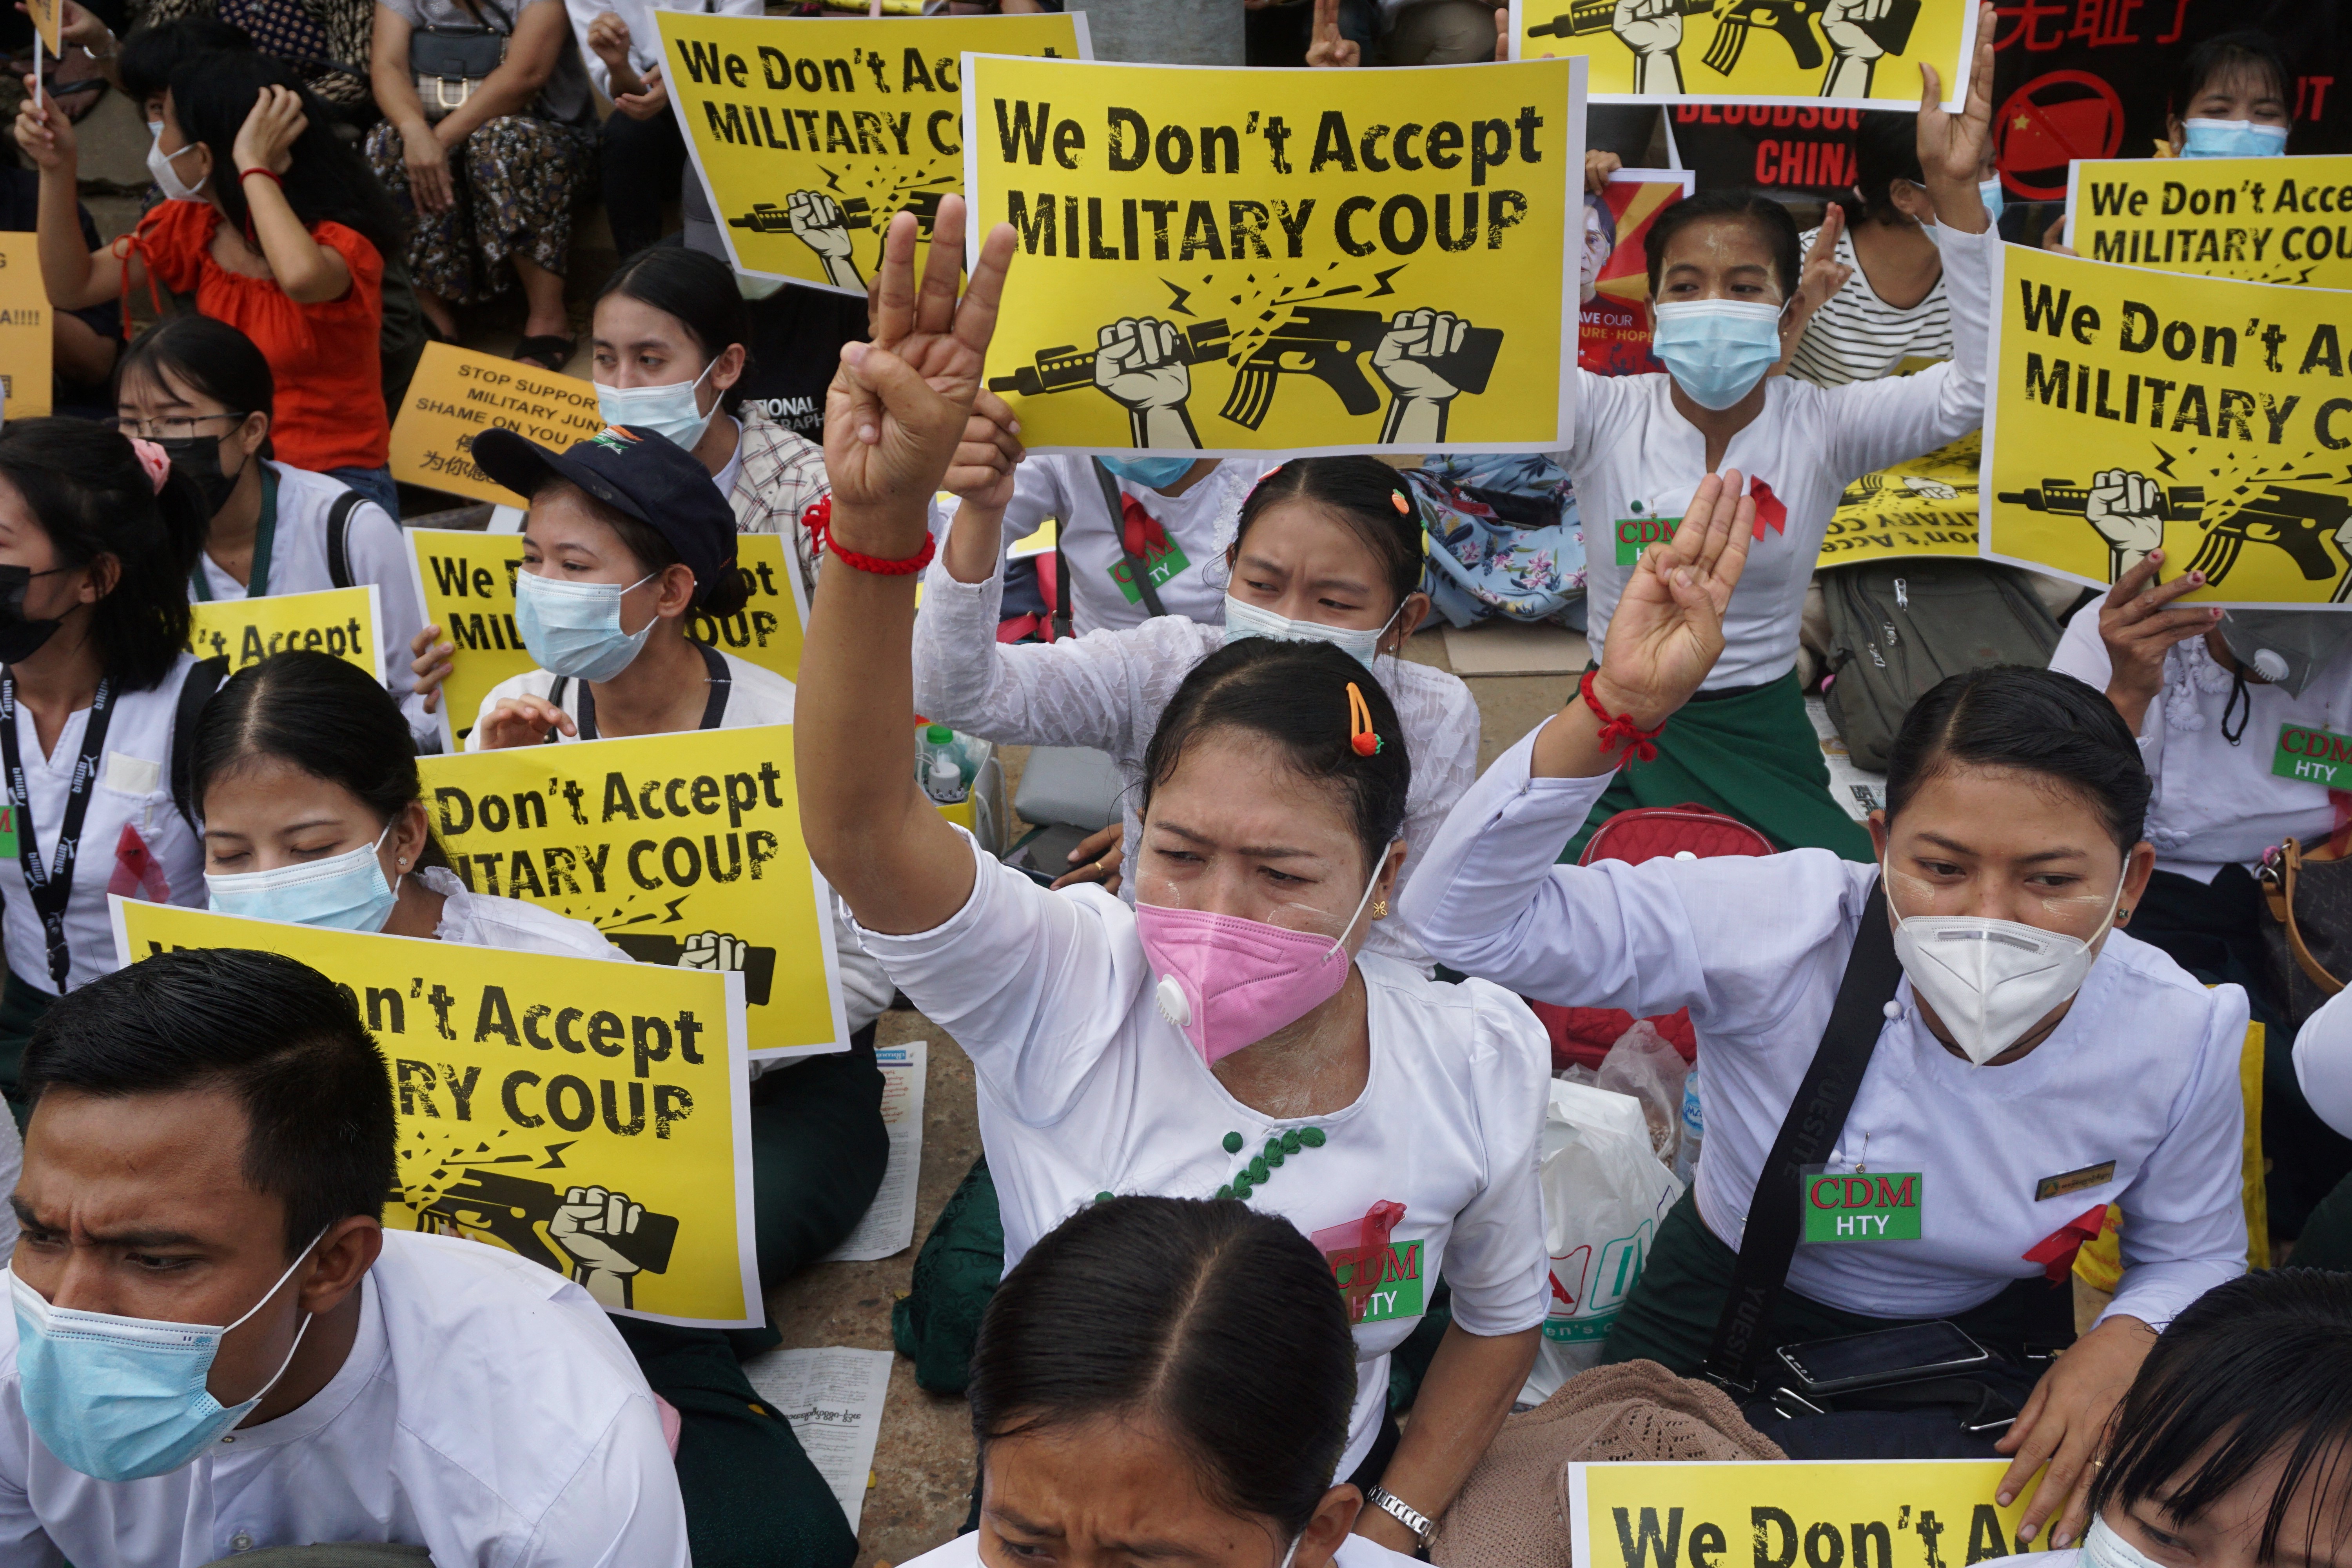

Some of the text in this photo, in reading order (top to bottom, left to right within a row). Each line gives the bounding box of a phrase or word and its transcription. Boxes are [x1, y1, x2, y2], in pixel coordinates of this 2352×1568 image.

[675, 38, 748, 88] We
[757, 46, 891, 93] Don't
[703, 101, 911, 155] MILITARY
[993, 98, 1085, 169] We
[1107, 107, 1293, 174] Don't
[1310, 105, 1544, 186] Accept
[2090, 181, 2149, 216] We
[2161, 179, 2265, 215] Don't
[1007, 189, 1528, 261] MILITARY COUP
[2093, 227, 2273, 263] MILITARY
[1579, 326, 1608, 338] URE
[1604, 314, 1632, 326] OUR
[2020, 278, 2100, 345] We
[2120, 300, 2287, 372] Don't
[458, 365, 600, 410] STOP SUPPOR
[467, 388, 558, 420] MILITARY
[2025, 352, 2300, 445] MILITARY
[416, 397, 568, 445] SHAME ON YOU
[430, 555, 494, 598] We
[686, 611, 778, 648] OUP
[2282, 728, 2352, 764] CDM
[2295, 760, 2337, 781] HTY
[435, 761, 783, 836] Don't Accept
[455, 830, 779, 899] ITARY COUP
[474, 985, 704, 1078] Accept
[502, 1071, 694, 1140] COUP
[1810, 1177, 1915, 1208] CDM
[1837, 1215, 1889, 1235] HTY
[1332, 1245, 1419, 1290] CDM
[1353, 1291, 1397, 1318] HTY
[1612, 1506, 1727, 1568] We
[1751, 1504, 1945, 1568] Don't
